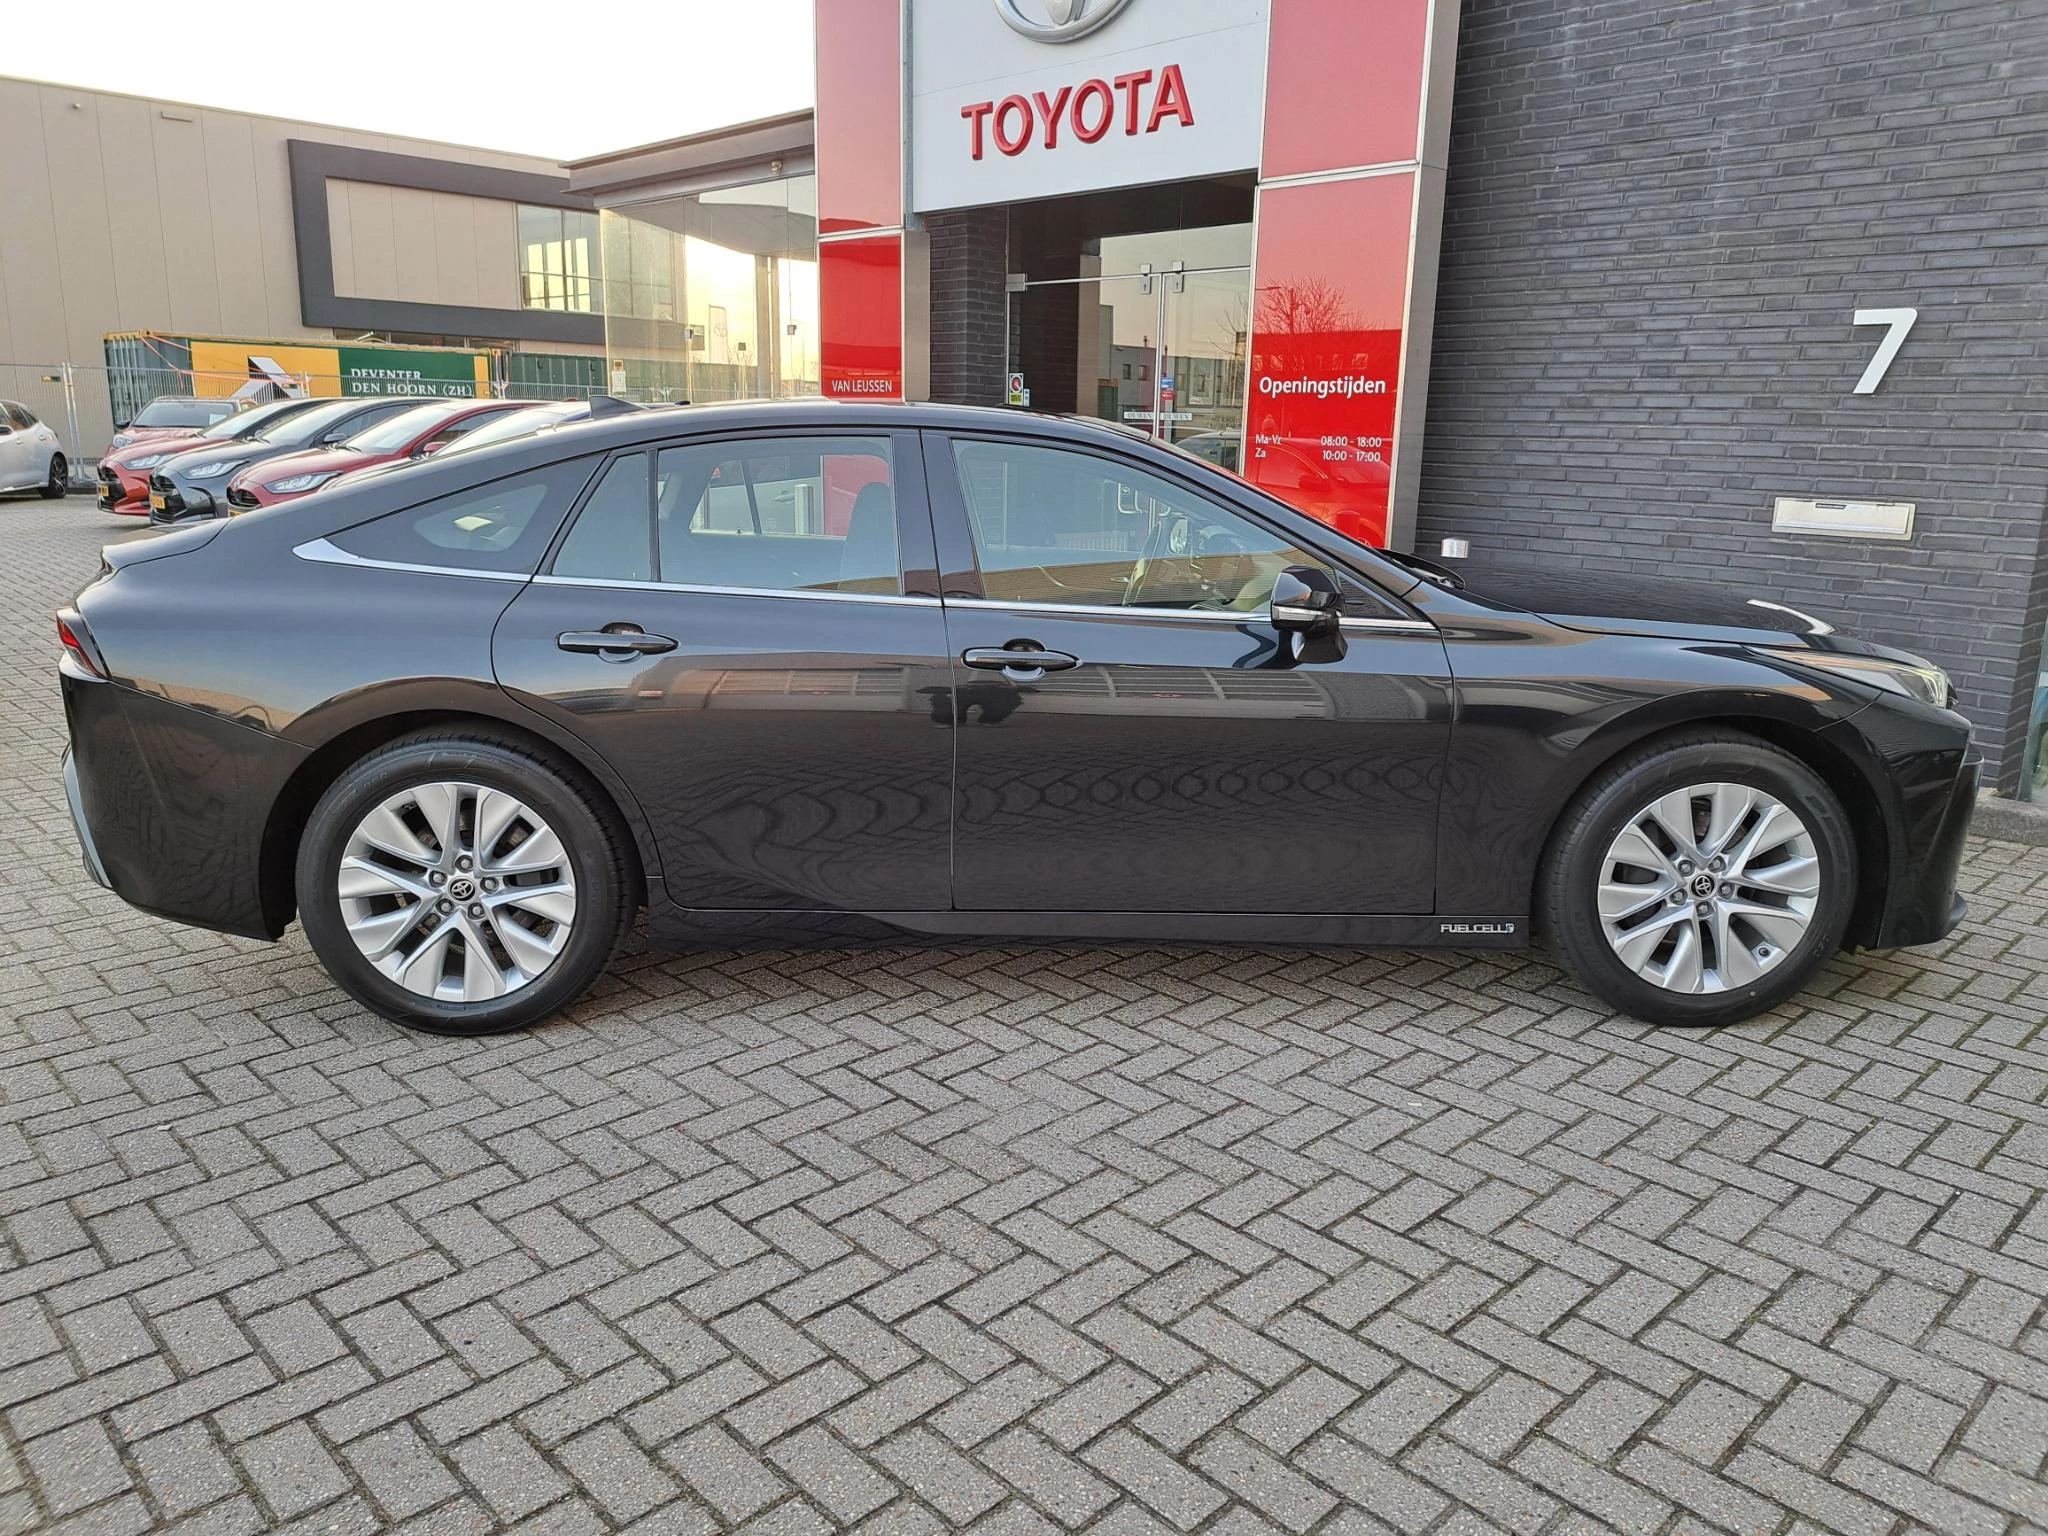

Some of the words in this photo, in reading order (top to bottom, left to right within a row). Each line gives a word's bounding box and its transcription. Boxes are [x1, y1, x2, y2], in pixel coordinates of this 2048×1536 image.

[961, 64, 1194, 160] TOYOTA
[1853, 308, 1918, 394] 7
[351, 368, 421, 380] DEVENTER
[352, 382, 380, 393] DEN
[386, 383, 436, 395] HOORN
[442, 384, 473, 396] (ZH)
[831, 379, 850, 392] VAN
[852, 379, 892, 393] LEUSSEN
[1260, 376, 1386, 399] Openingstijden
[1320, 436, 1348, 446] 08:00
[1357, 437, 1382, 447] 18:00
[1255, 448, 1266, 458] Za
[1322, 450, 1347, 460] 10:00
[1356, 451, 1381, 462] 17:00
